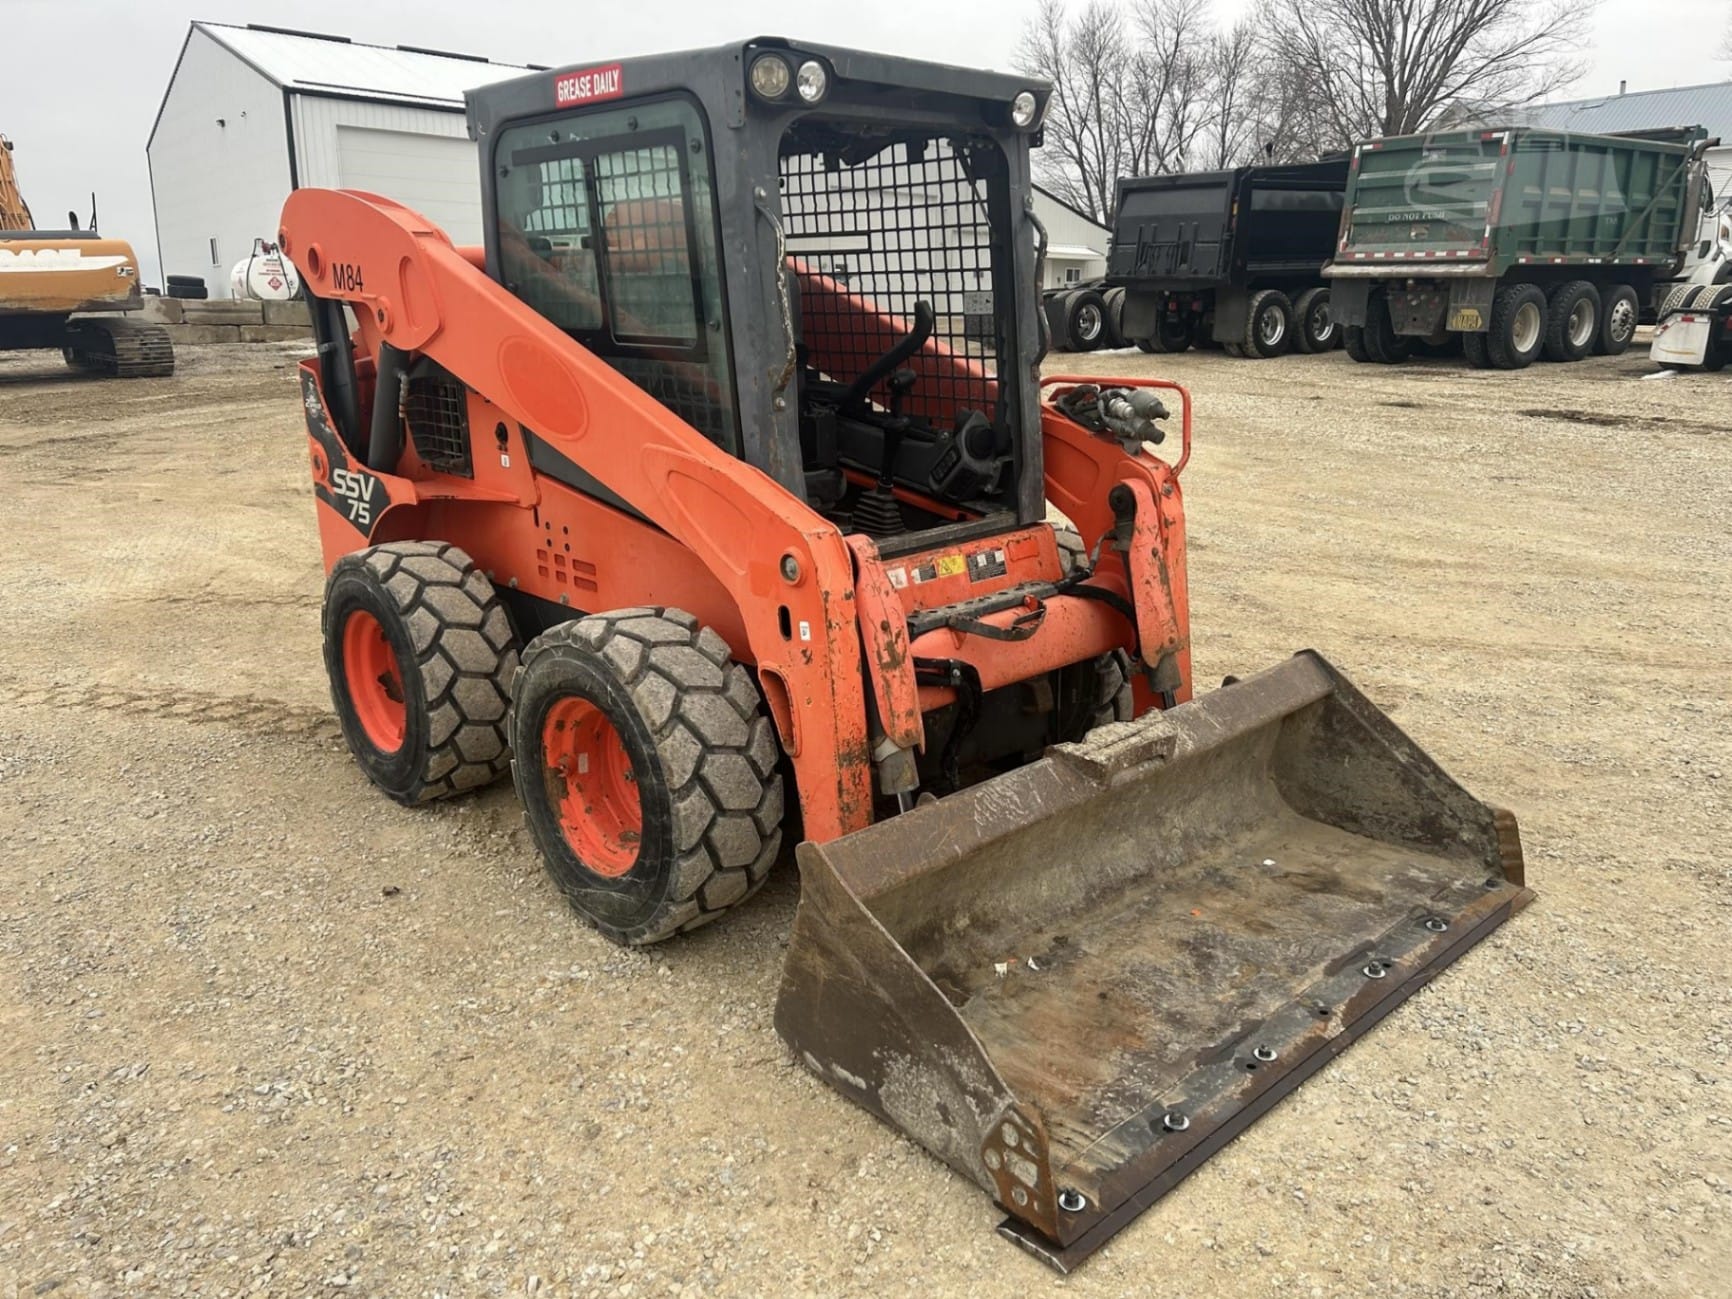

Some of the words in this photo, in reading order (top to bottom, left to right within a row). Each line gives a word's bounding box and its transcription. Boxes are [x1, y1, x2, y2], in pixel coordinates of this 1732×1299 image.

[557, 75, 592, 102] GREASE
[593, 69, 619, 96] DAILY
[332, 262, 363, 293] M84
[333, 467, 375, 502] SSV
[347, 498, 370, 525] 75
